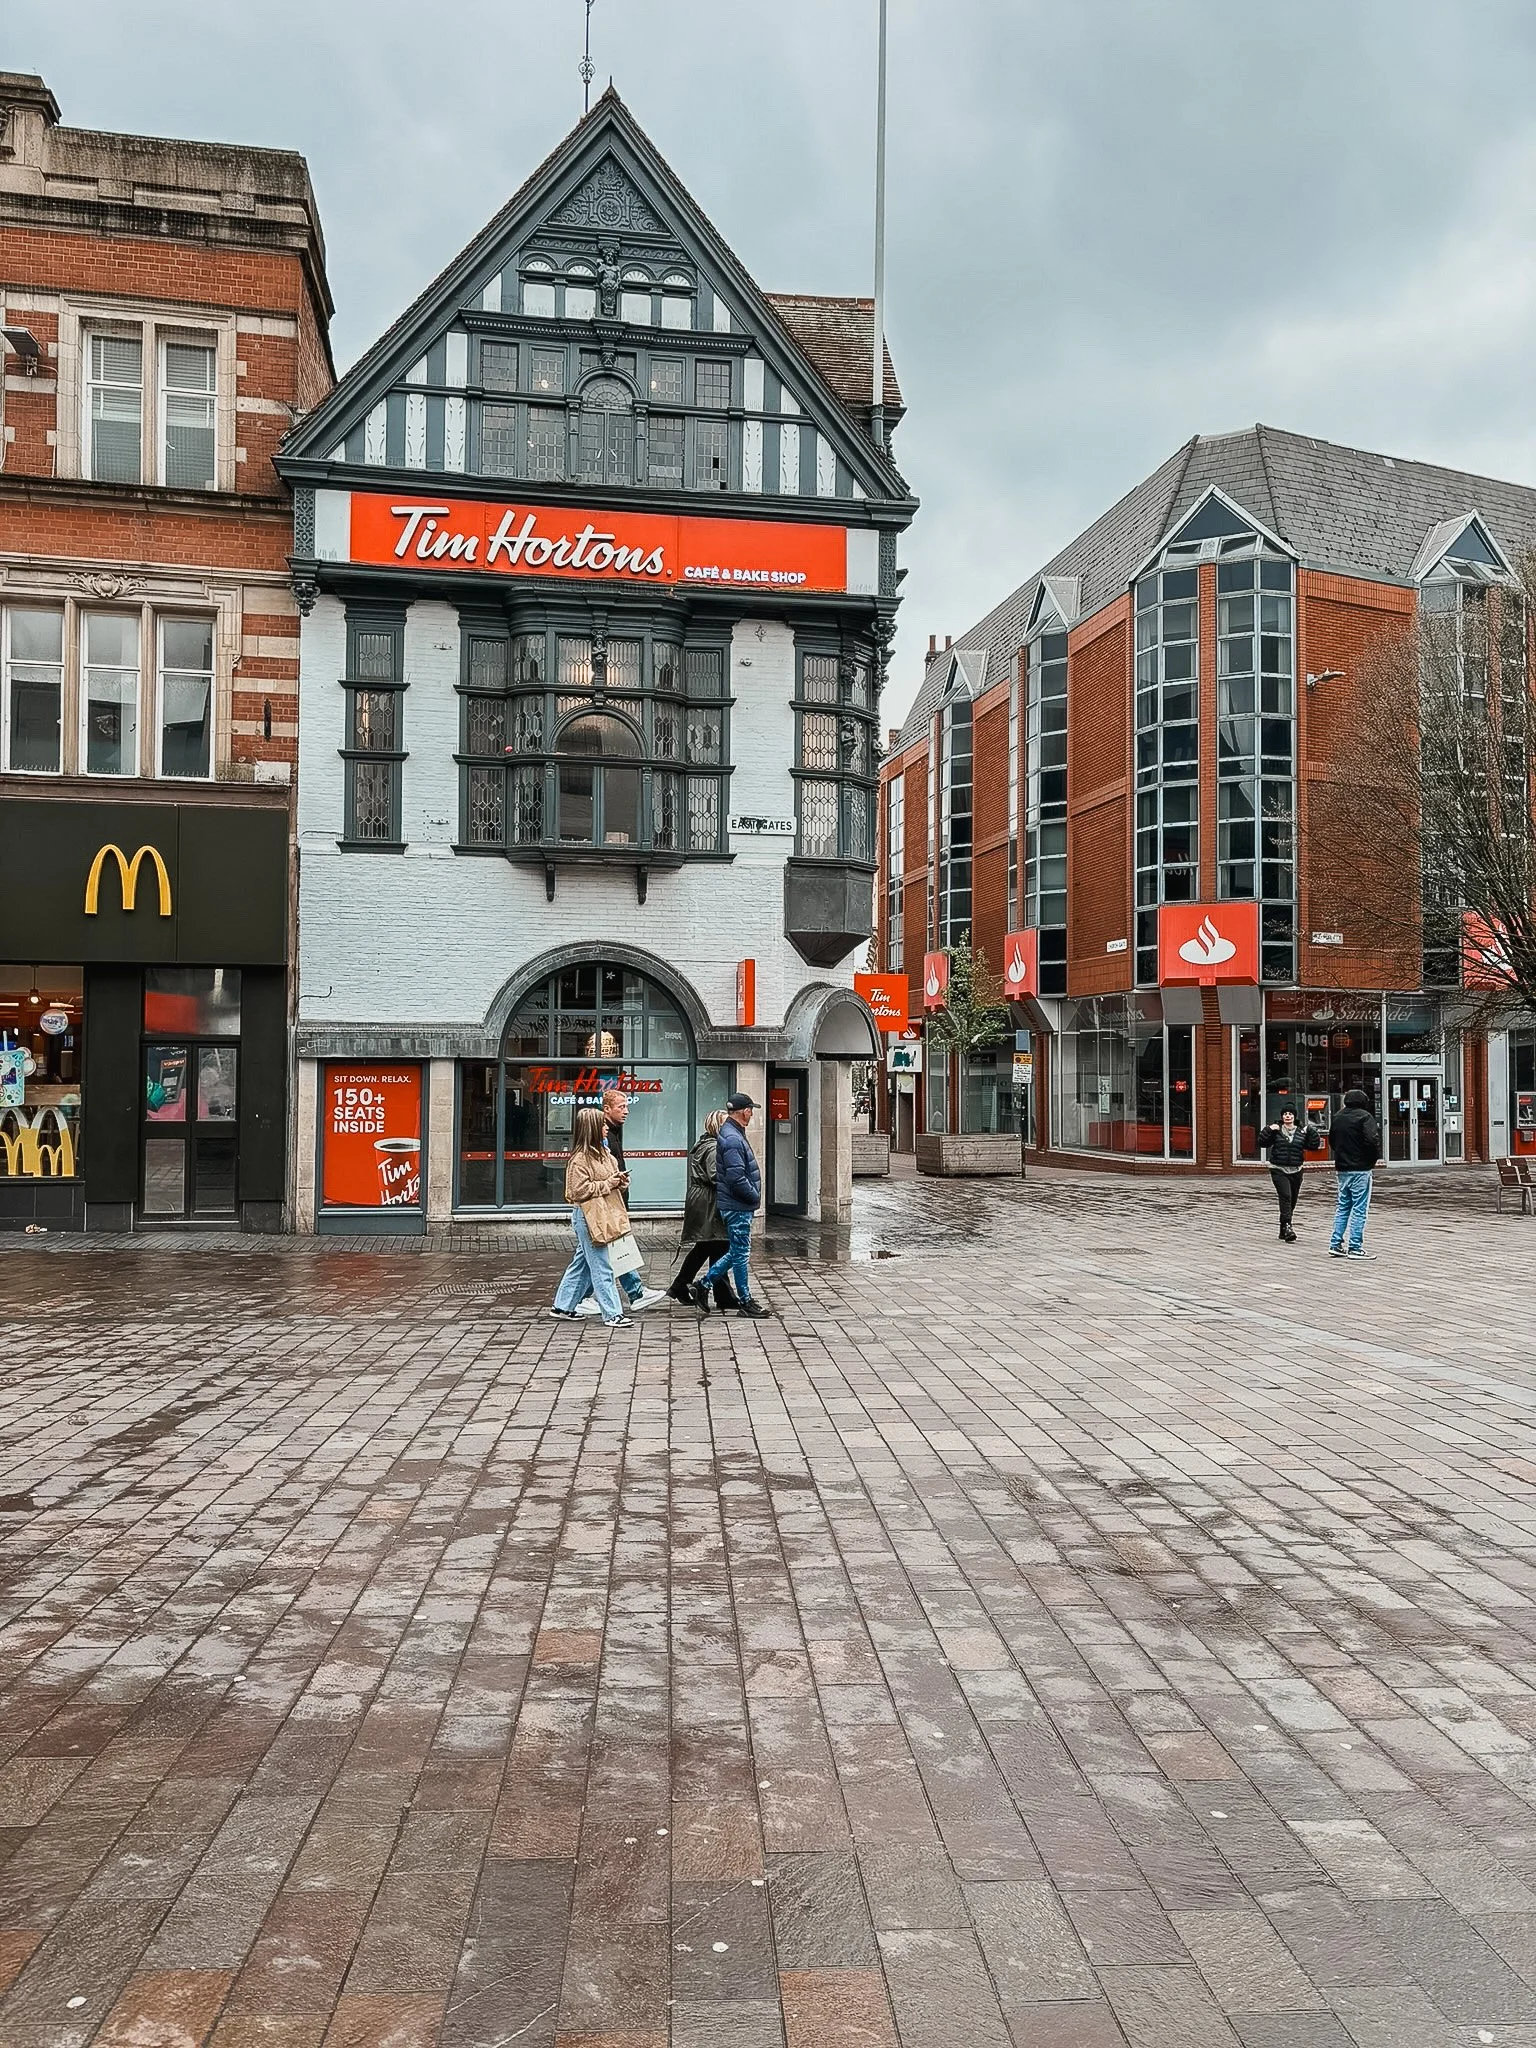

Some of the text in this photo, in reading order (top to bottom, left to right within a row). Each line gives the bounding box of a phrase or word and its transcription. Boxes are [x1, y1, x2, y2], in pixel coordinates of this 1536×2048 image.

[391, 506, 480, 562] Tim
[684, 566, 806, 584] CAFÉ & BAKE SHOP
[870, 988, 890, 1002] Tim
[1335, 1009, 1415, 1021] Santader
[527, 1067, 663, 1093] Tim Hortons
[333, 1088, 385, 1106] 150+
[550, 1094, 576, 1105] CAFÉ
[577, 1097, 584, 1105] &
[333, 1106, 385, 1120] SEATS
[333, 1120, 385, 1133] INSIDE
[378, 1157, 413, 1186] Tim
